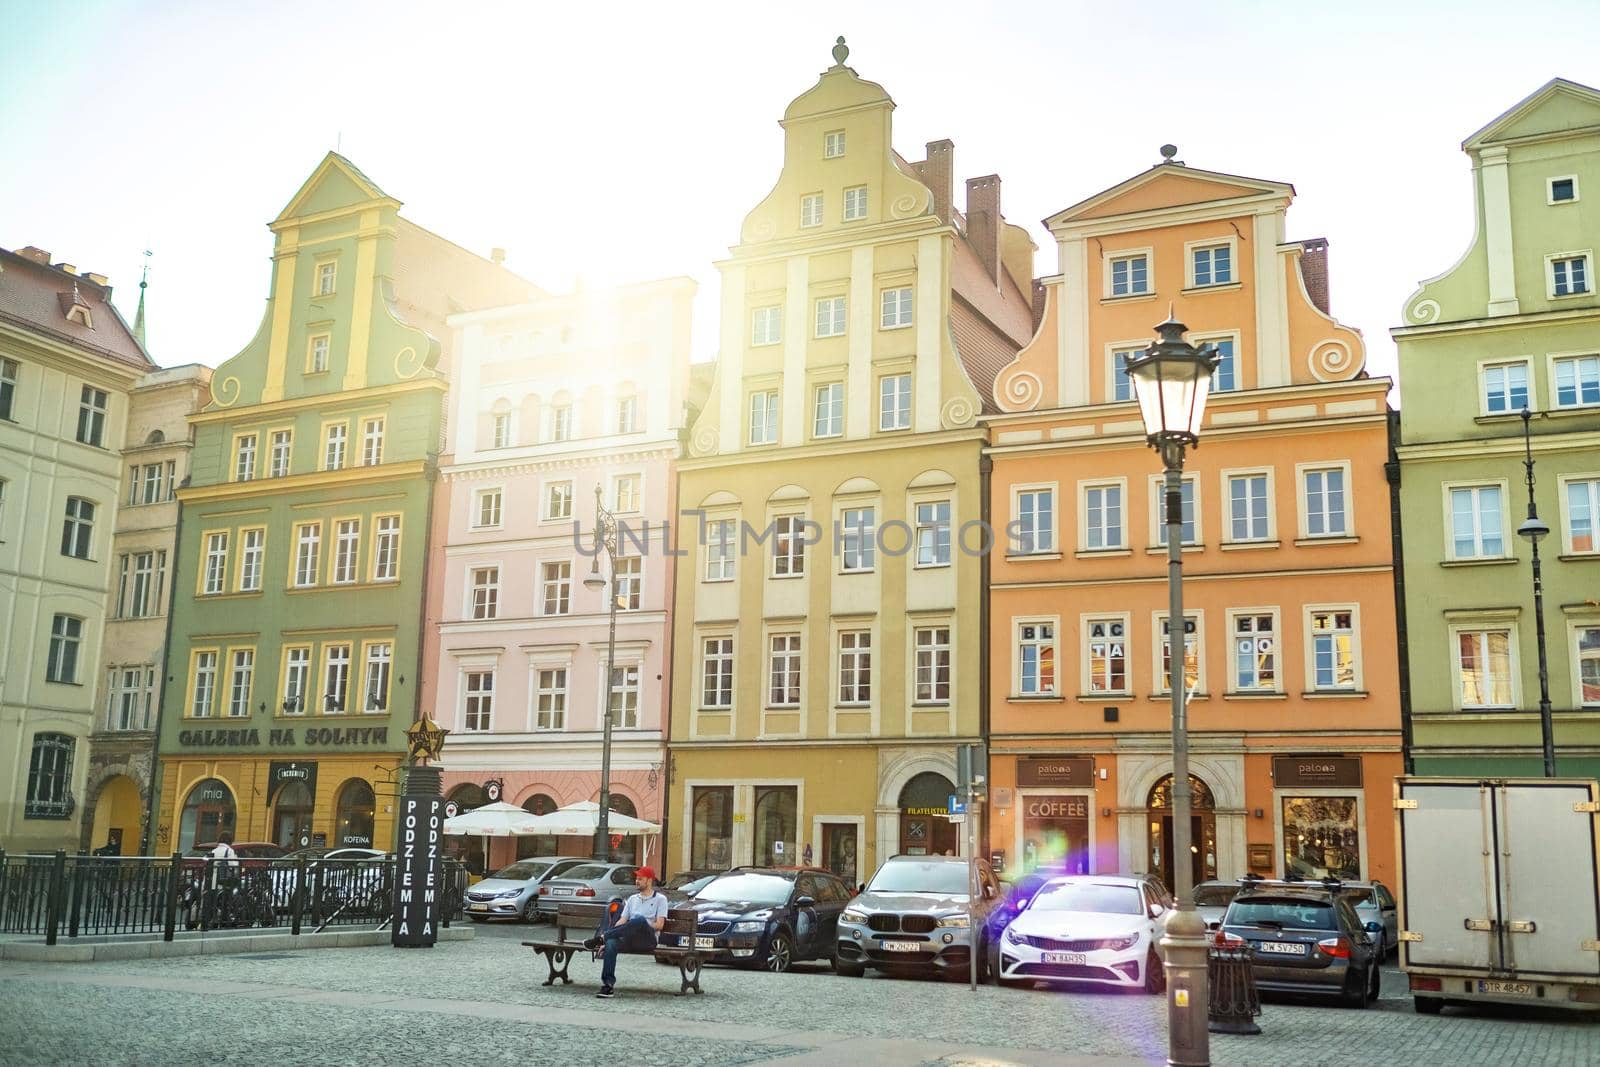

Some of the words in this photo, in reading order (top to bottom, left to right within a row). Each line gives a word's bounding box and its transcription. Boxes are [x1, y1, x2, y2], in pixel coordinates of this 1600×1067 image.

[178, 729, 260, 747] GALERIA
[268, 728, 296, 746] NA
[304, 726, 389, 746] SOLNYM
[203, 788, 223, 800] mia
[907, 807, 952, 816] FILATELISTYK
[1029, 803, 1085, 817] COFFEE
[343, 836, 370, 844] KOFEINA
[399, 800, 417, 936] PODZIEMIA
[422, 800, 439, 936] PODZIEMIA
